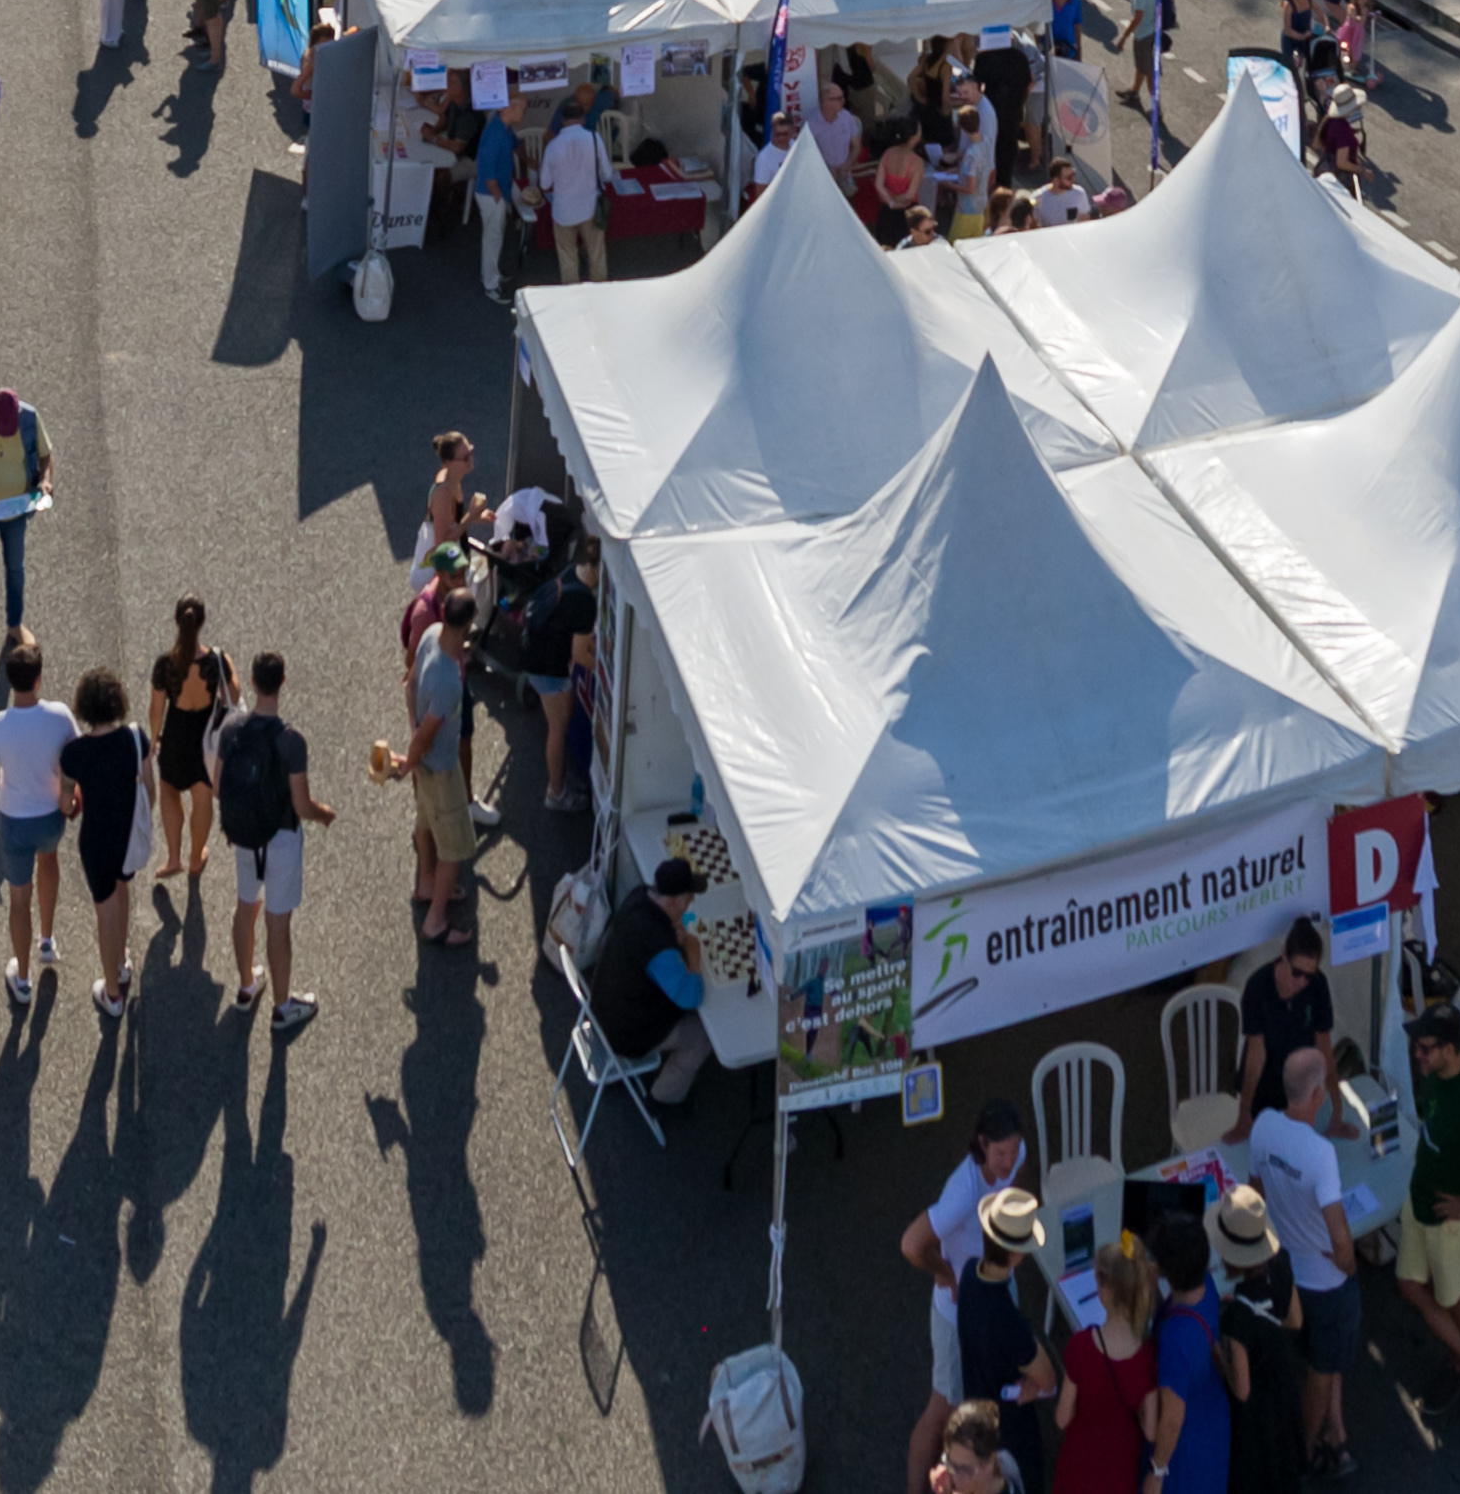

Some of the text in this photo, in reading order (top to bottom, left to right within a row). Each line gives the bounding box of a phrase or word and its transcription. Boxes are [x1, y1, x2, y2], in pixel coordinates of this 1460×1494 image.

[1353, 827, 1400, 906] D
[986, 834, 1307, 966] entraînement naturel
[1125, 908, 1228, 952] PARCOURS
[824, 959, 907, 994] Se mettre
[785, 998, 893, 1033] c'est dehors
[831, 992, 852, 1006] au
